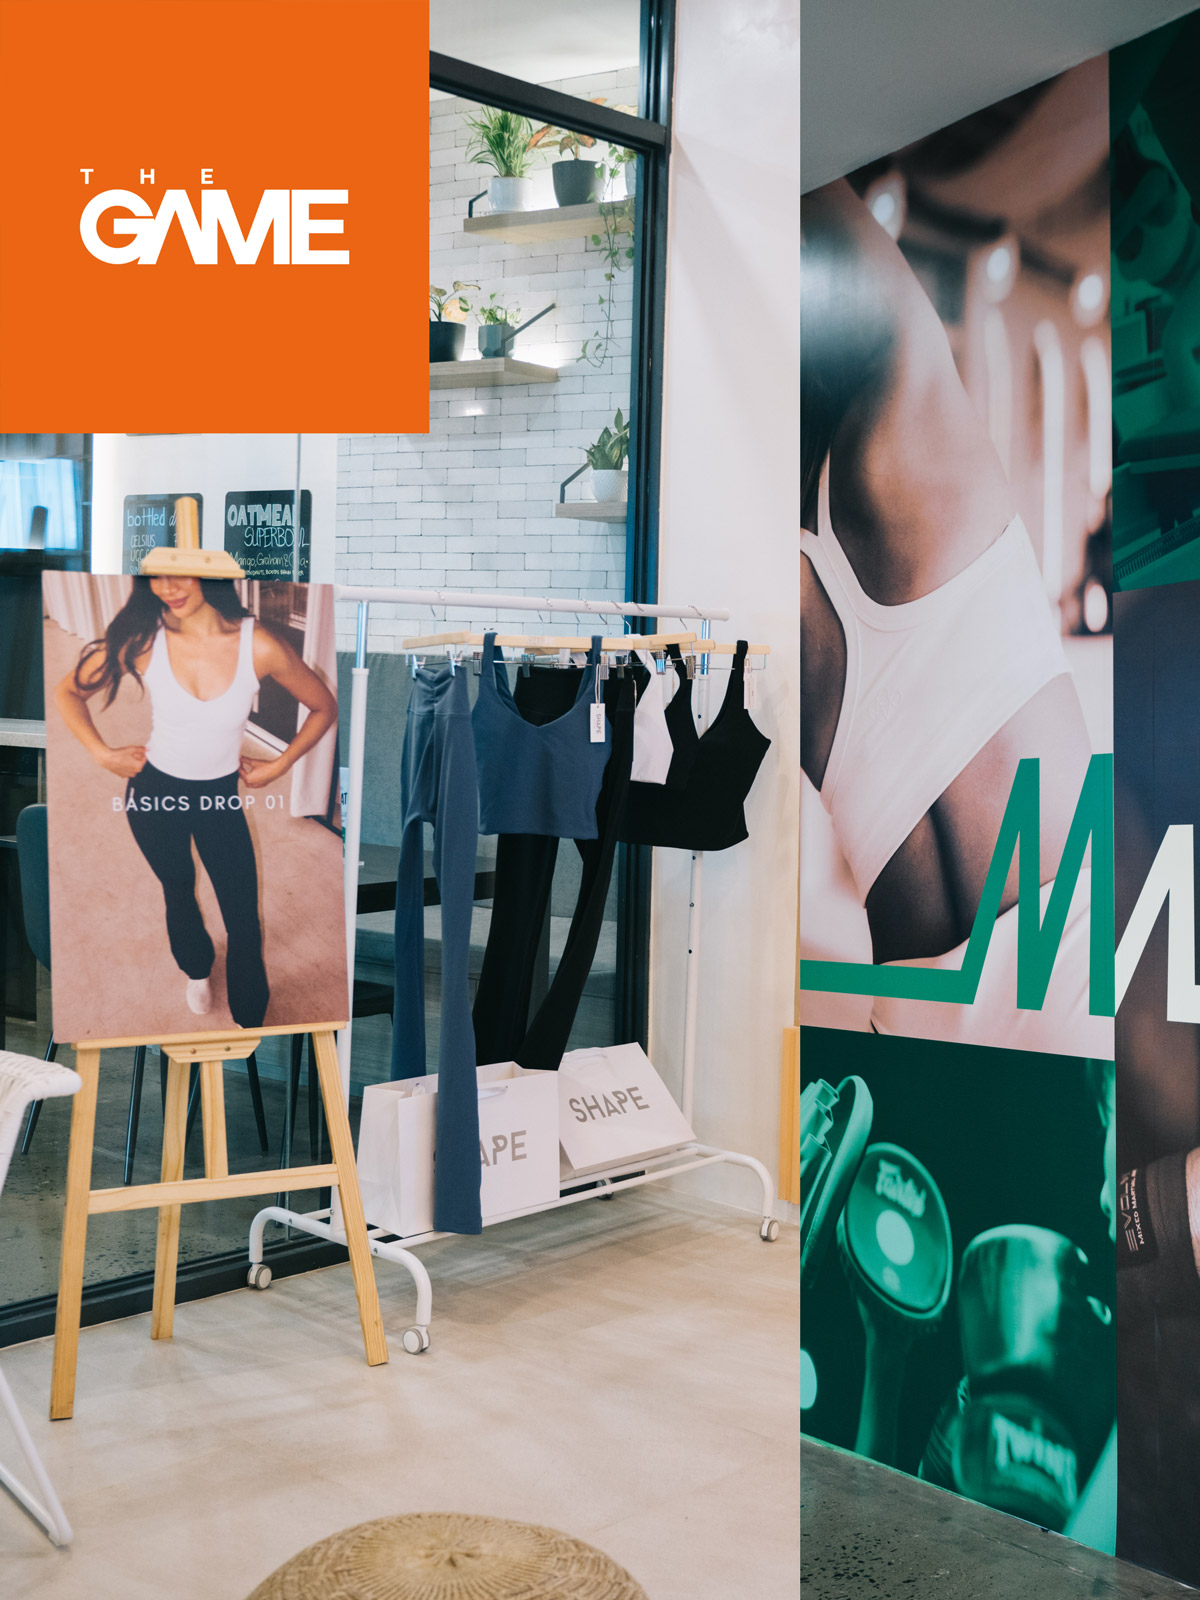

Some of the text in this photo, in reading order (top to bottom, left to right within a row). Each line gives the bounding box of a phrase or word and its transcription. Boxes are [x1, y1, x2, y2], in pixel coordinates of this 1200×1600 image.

[127, 506, 166, 527] bottled
[130, 534, 156, 548] CELSIUS
[243, 526, 310, 548] SUPERBOL
[112, 794, 284, 812] BASICS DROP 01
[568, 1086, 650, 1123] SHAPE
[1133, 1210, 1145, 1245] MIXED
